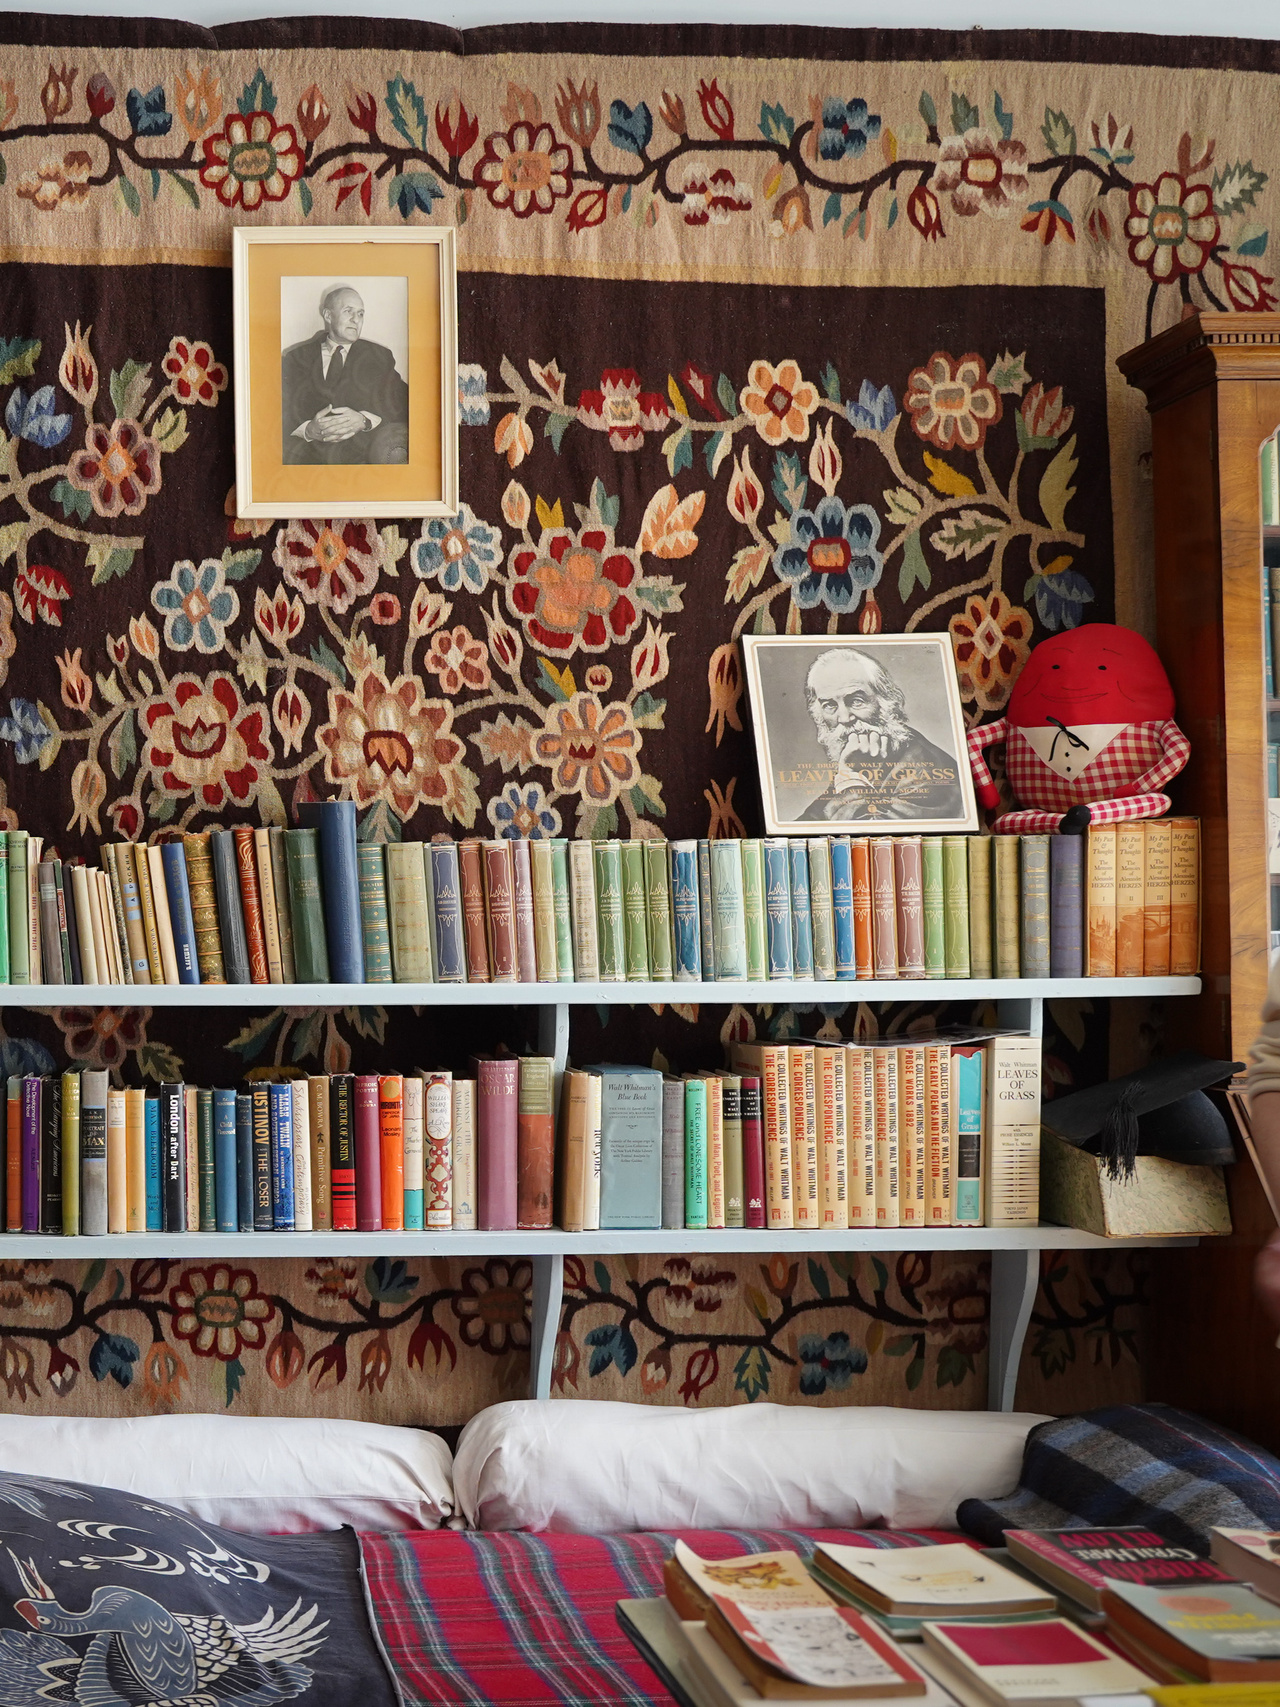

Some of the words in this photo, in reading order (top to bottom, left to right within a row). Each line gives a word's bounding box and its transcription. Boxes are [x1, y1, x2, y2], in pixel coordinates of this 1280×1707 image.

[777, 769, 850, 783] LEAVES
[858, 769, 884, 781] OF
[891, 768, 956, 780] GRASS
[124, 854, 134, 889] РОСКИН
[171, 859, 182, 887] ЧЕХОВ
[793, 1053, 803, 1068] THE
[823, 1056, 832, 1071] THE
[834, 1051, 842, 1062] THE
[852, 1052, 861, 1067] THE
[876, 1055, 885, 1069] THE
[915, 1050, 923, 1061] THE
[929, 1049, 938, 1064] THE
[940, 1049, 948, 1060] THE
[480, 1074, 516, 1084] OSCAR
[835, 1064, 844, 1101] COLLECTED
[915, 1063, 924, 1101] COLLECTED
[929, 1065, 939, 1087] EARLY
[940, 1062, 949, 1099] COLLECTED
[997, 1070, 1038, 1079] LEAVES
[338, 1083, 347, 1098] THE
[480, 1085, 516, 1095] WILDE
[608, 1083, 623, 1091] Walt
[623, 1083, 656, 1091] Whitman's
[712, 1084, 720, 1100] Walt
[1009, 1080, 1025, 1089] OF
[617, 1093, 630, 1101] Blue
[632, 1093, 647, 1101] Book
[852, 1070, 862, 1139] CORRESPONDENCE
[930, 1089, 939, 1115] POEMS
[999, 1091, 1036, 1100] GRASS
[169, 1094, 180, 1134] London
[278, 1093, 289, 1118] MARK
[339, 1099, 348, 1126] RECTOR
[794, 1071, 804, 1141] CORRESPONDENCE
[823, 1074, 834, 1144] CORRESPONDENCE
[876, 1072, 886, 1142] CORRESPONDENCE
[960, 1108, 980, 1116] Leaves
[254, 1091, 269, 1145] USTINOV
[294, 1086, 304, 1149] Shakespeare
[712, 1102, 721, 1132] Whitman
[835, 1104, 844, 1136] WRITINGS
[916, 1103, 924, 1135] WRITINGS
[930, 1116, 939, 1131] AND
[941, 1102, 949, 1134] WRITINGS
[961, 1122, 979, 1131] Grass
[279, 1121, 290, 1148] TWAIN
[339, 1127, 348, 1136] OF
[713, 1133, 719, 1142] as
[931, 1132, 940, 1146] THE
[82, 1137, 105, 1146] MAX
[170, 1137, 178, 1158] after
[339, 1137, 349, 1161] JUSTIN
[712, 1143, 721, 1160] Man,
[836, 1148, 845, 1167] WALT
[916, 1147, 924, 1166] WALT
[941, 1146, 949, 1164] WALT
[170, 1161, 179, 1180] Dark
[258, 1152, 268, 1172] THE
[317, 1146, 326, 1182] Primitive
[711, 1161, 721, 1179] Poet,
[931, 1148, 940, 1178] FICTION
[258, 1176, 269, 1208] LOSER
[294, 1154, 305, 1216] Contemporary
[713, 1180, 721, 1192] and
[837, 1170, 846, 1201] WHITMAN
[916, 1169, 924, 1200] WHITMAN
[942, 1167, 950, 1199] WHITMAN
[316, 1184, 327, 1204] Song
[711, 1193, 722, 1218] Legend
[1058, 1531, 1134, 1548] Law
[1069, 1549, 1127, 1562] HARE
[1126, 1547, 1198, 1561] CYRIL
[1098, 1558, 1237, 1587] Tragedy
